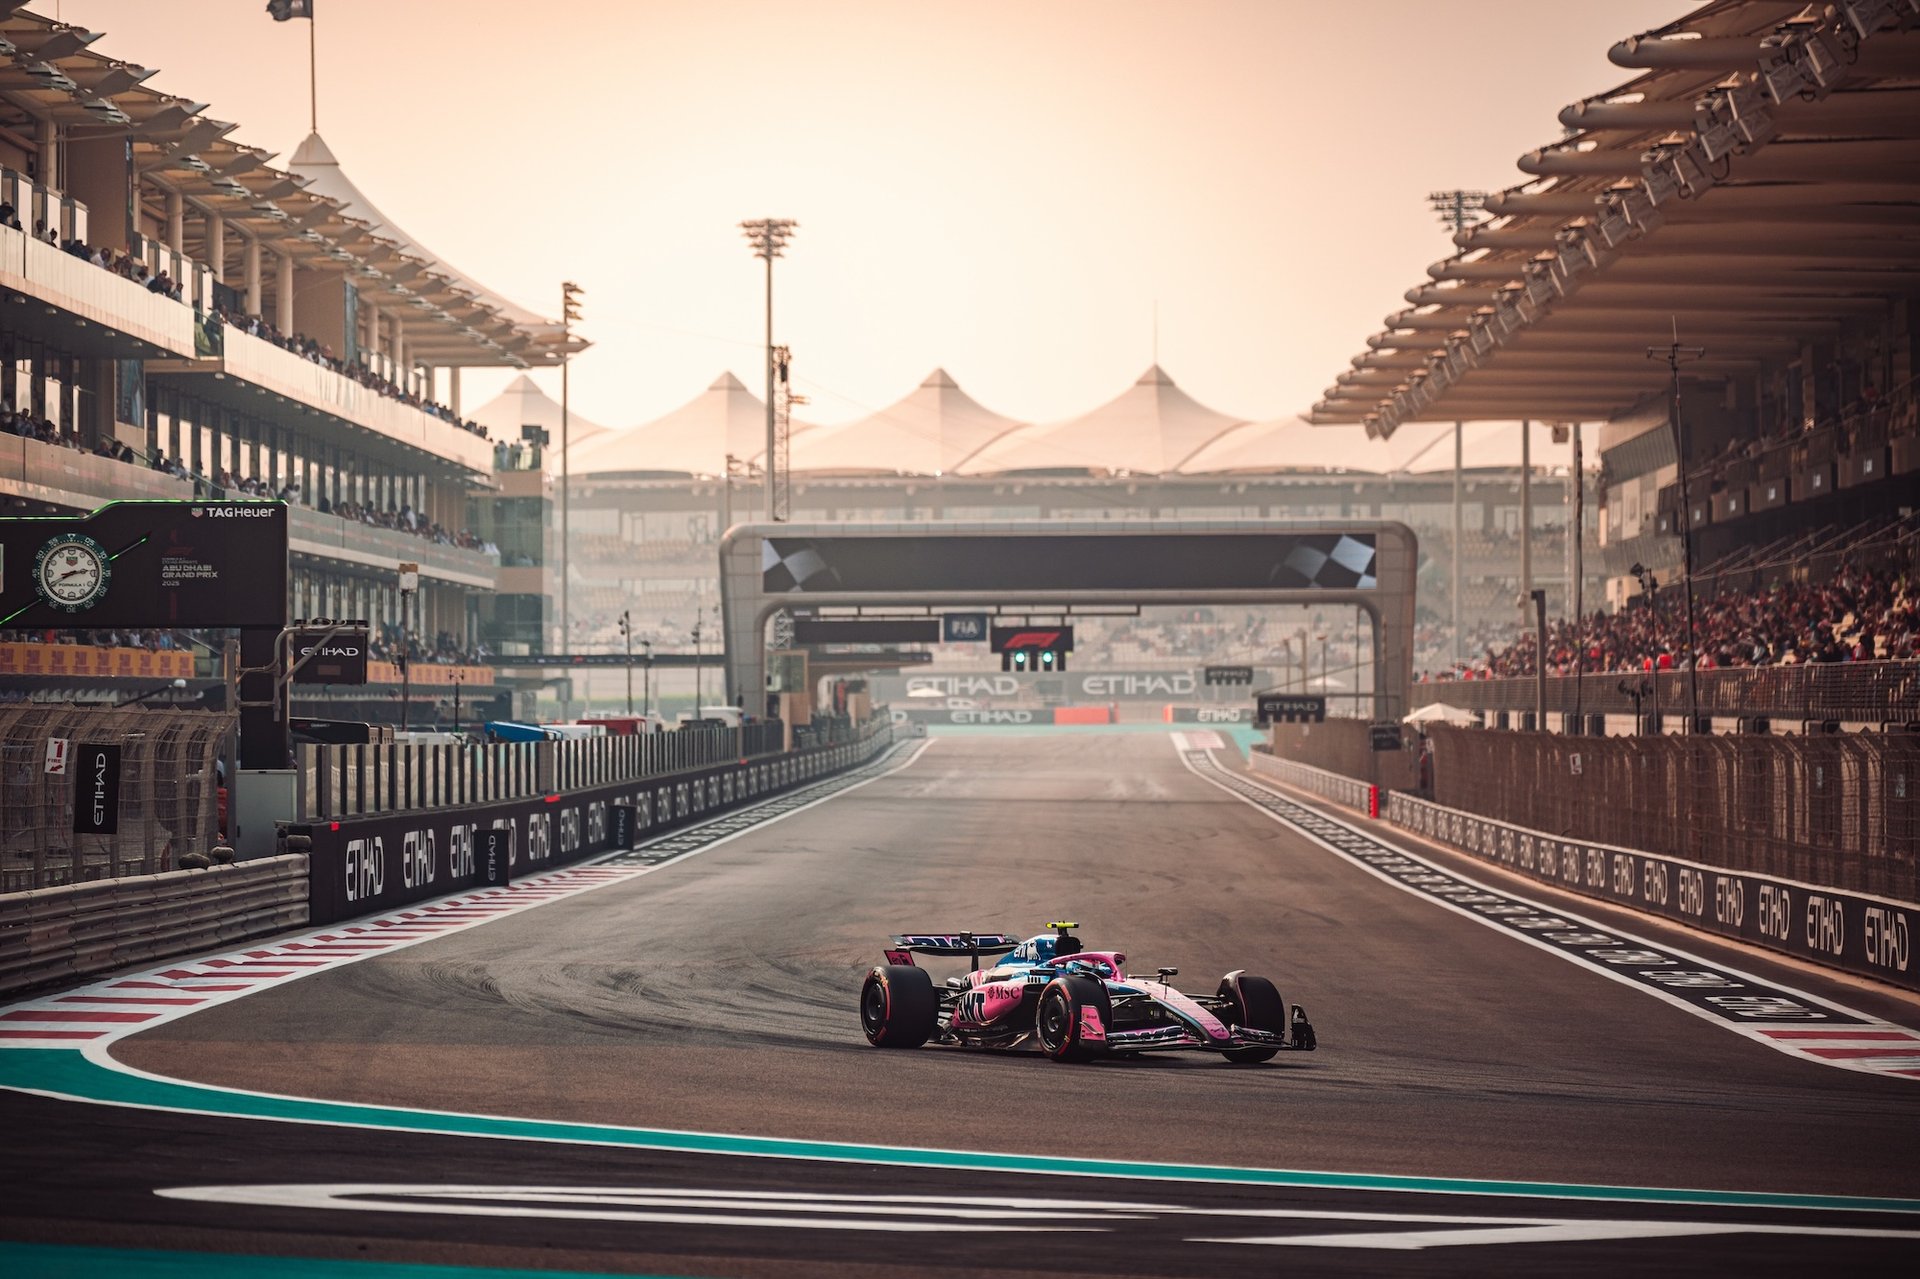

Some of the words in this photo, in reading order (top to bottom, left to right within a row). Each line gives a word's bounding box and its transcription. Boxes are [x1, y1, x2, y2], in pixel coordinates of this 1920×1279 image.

[161, 571, 195, 579] GRAND
[196, 571, 219, 579] PRIX
[162, 564, 182, 572] ABU
[183, 564, 213, 572] DHABI
[951, 620, 979, 635] FIA
[1082, 674, 1197, 696] ETIHAD
[1263, 702, 1320, 712] ETIHAD
[950, 710, 1033, 723] ETIHAD
[93, 752, 107, 827] ETIHAD
[345, 836, 384, 902] ETIHAD
[403, 828, 435, 889] ETIHAD
[450, 823, 478, 878] ETIHA
[487, 834, 496, 882] ETIHAD
[1644, 860, 1668, 906] ETIHAD
[1679, 868, 1704, 916] ETIHAD
[1716, 876, 1744, 928] ETIHAD
[1759, 884, 1791, 941] ETIHAD
[1807, 895, 1844, 955] ETIHAD
[1864, 906, 1909, 972] ETIHAD
[995, 986, 1020, 1000] MSC
